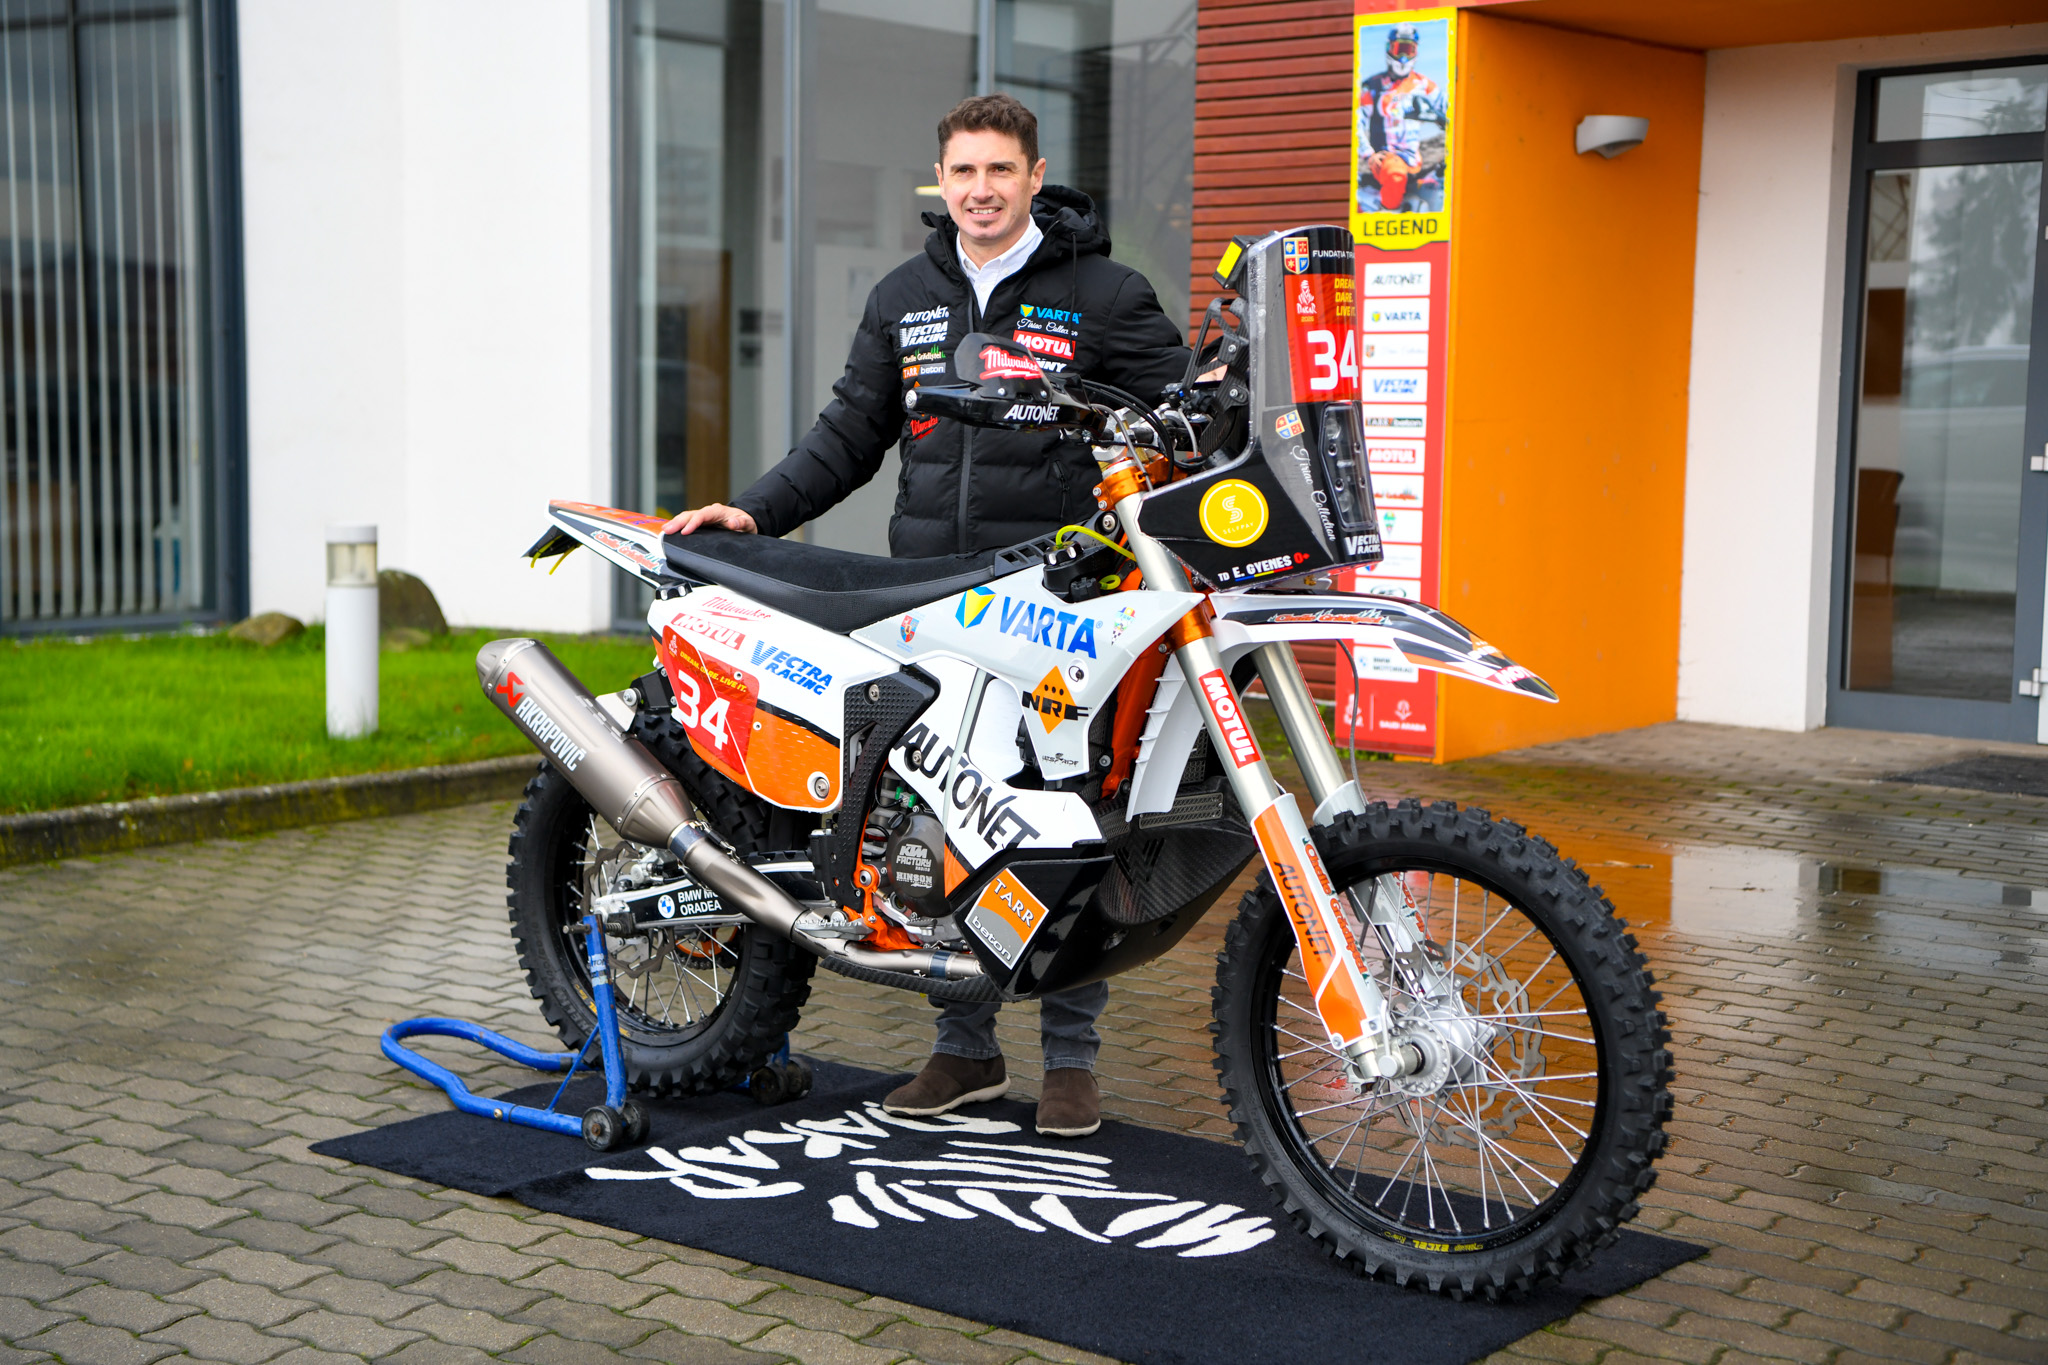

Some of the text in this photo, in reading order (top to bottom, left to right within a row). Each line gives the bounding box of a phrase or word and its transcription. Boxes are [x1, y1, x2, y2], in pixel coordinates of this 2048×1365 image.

[1363, 219, 1438, 236] LEGEND
[1372, 273, 1423, 285] AUTONET
[1036, 306, 1079, 325] VARTA
[1384, 311, 1422, 321] VARTA
[899, 321, 948, 348] VECTRA
[909, 332, 948, 346] RACING
[1016, 334, 1072, 357] MOTUL
[983, 347, 1039, 372] Milwaukee
[1307, 329, 1359, 390] 34
[903, 365, 944, 379] TARR beton
[1004, 402, 1060, 424] AUTONET
[1370, 450, 1415, 461] MOTUL
[1311, 489, 1337, 542] Collection
[1222, 522, 1254, 535] SELFPAY
[1345, 534, 1380, 555] VECTRA
[1218, 572, 1230, 582] TD
[1232, 566, 1245, 579] E.
[1246, 555, 1292, 576] GYENES
[702, 595, 771, 619] Milwaukee
[674, 615, 741, 650] MOTUL
[1000, 596, 1097, 659] VARTA
[680, 650, 747, 693] DREAM. DARE. LIVE IT.
[750, 639, 833, 687] VECTRA
[764, 662, 827, 695] RACING
[677, 669, 731, 751] 34
[1022, 691, 1090, 721] NRF
[1203, 676, 1256, 762] MOTUL
[894, 722, 1042, 851] AUTONET
[896, 855, 932, 867] FACTORY
[899, 844, 928, 858] KTM
[896, 872, 932, 885] HINSON
[678, 889, 702, 903] BMW
[680, 900, 722, 916] ORADEA
[993, 878, 1034, 929] TARR
[1273, 860, 1336, 958] AUTONET
[972, 915, 1013, 962] beton
[1252, 1118, 1281, 1163] MEDIUM
[1412, 1239, 1449, 1252] EXCEL
